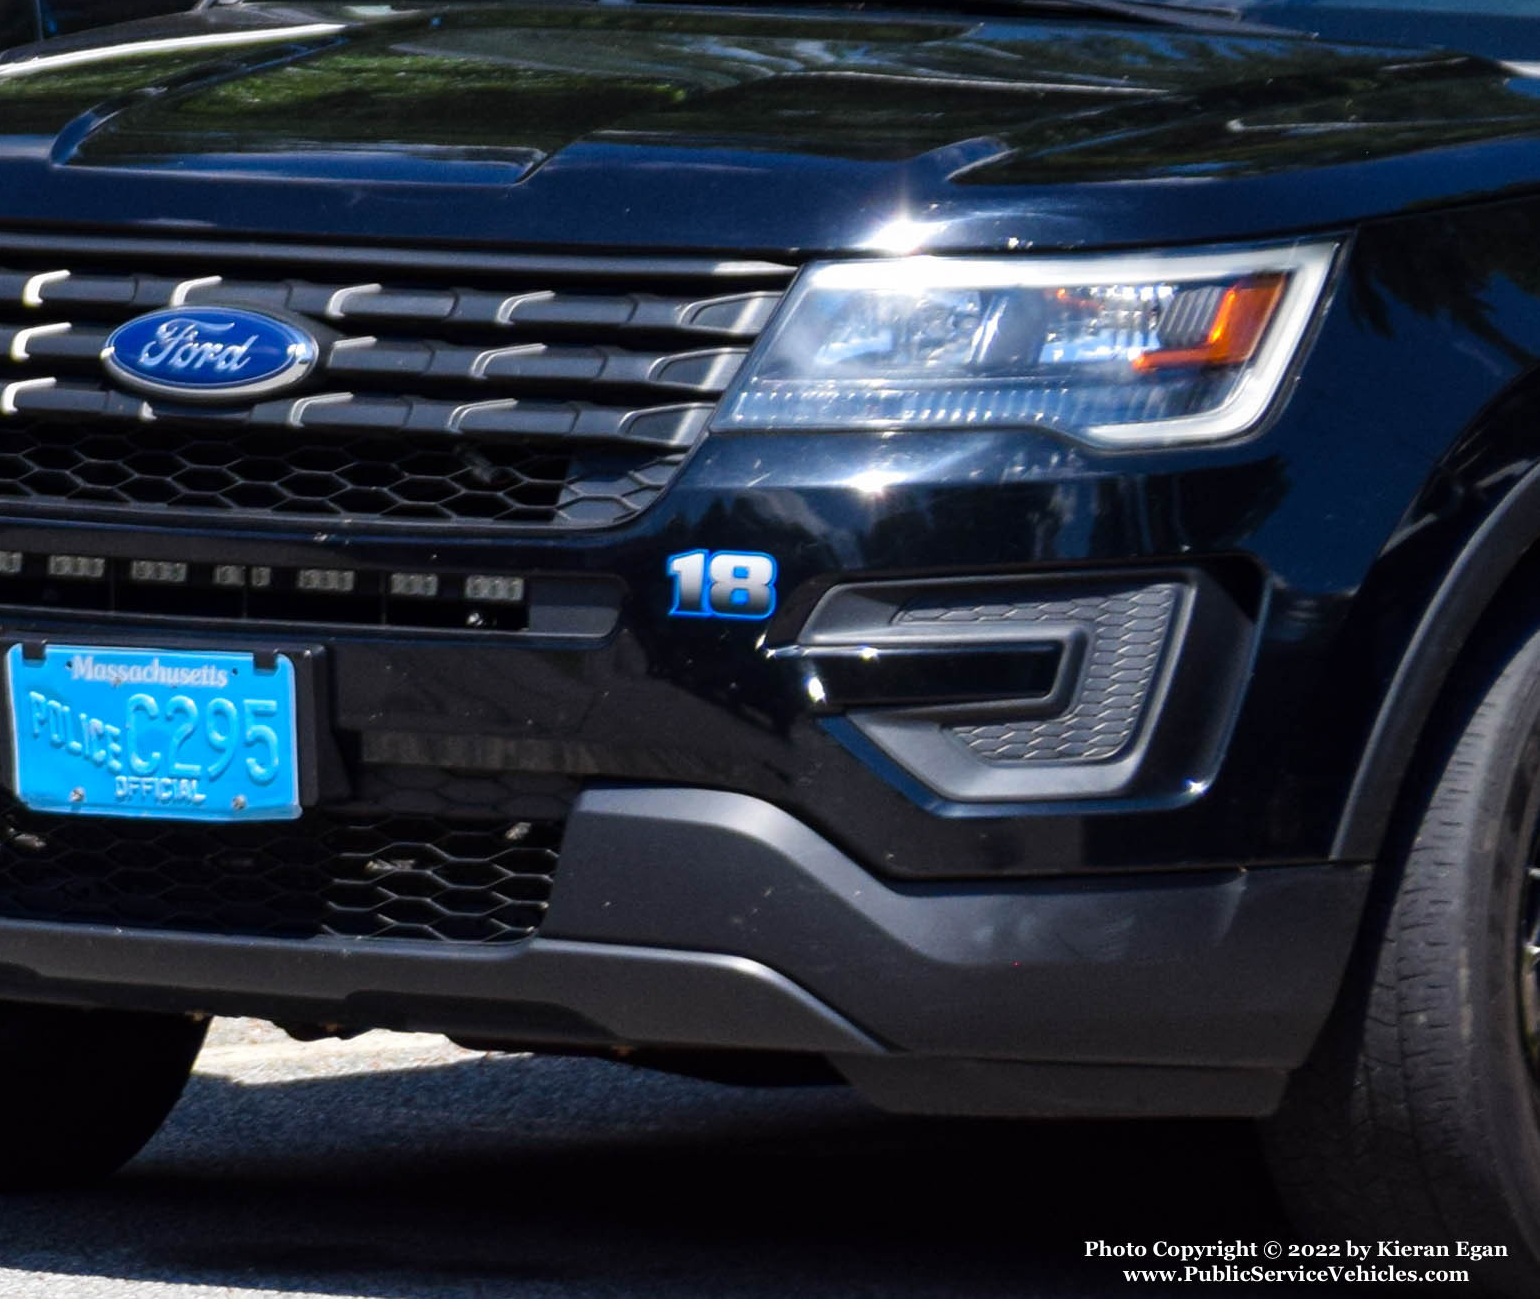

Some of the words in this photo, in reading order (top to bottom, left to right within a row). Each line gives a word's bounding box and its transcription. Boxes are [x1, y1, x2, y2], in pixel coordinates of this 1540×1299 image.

[138, 317, 258, 372] Ford
[667, 548, 777, 620] 18
[71, 655, 229, 687] Massachusetts
[29, 691, 122, 776] POLICE
[127, 693, 279, 785] C295
[115, 775, 206, 804] OFFICIAL
